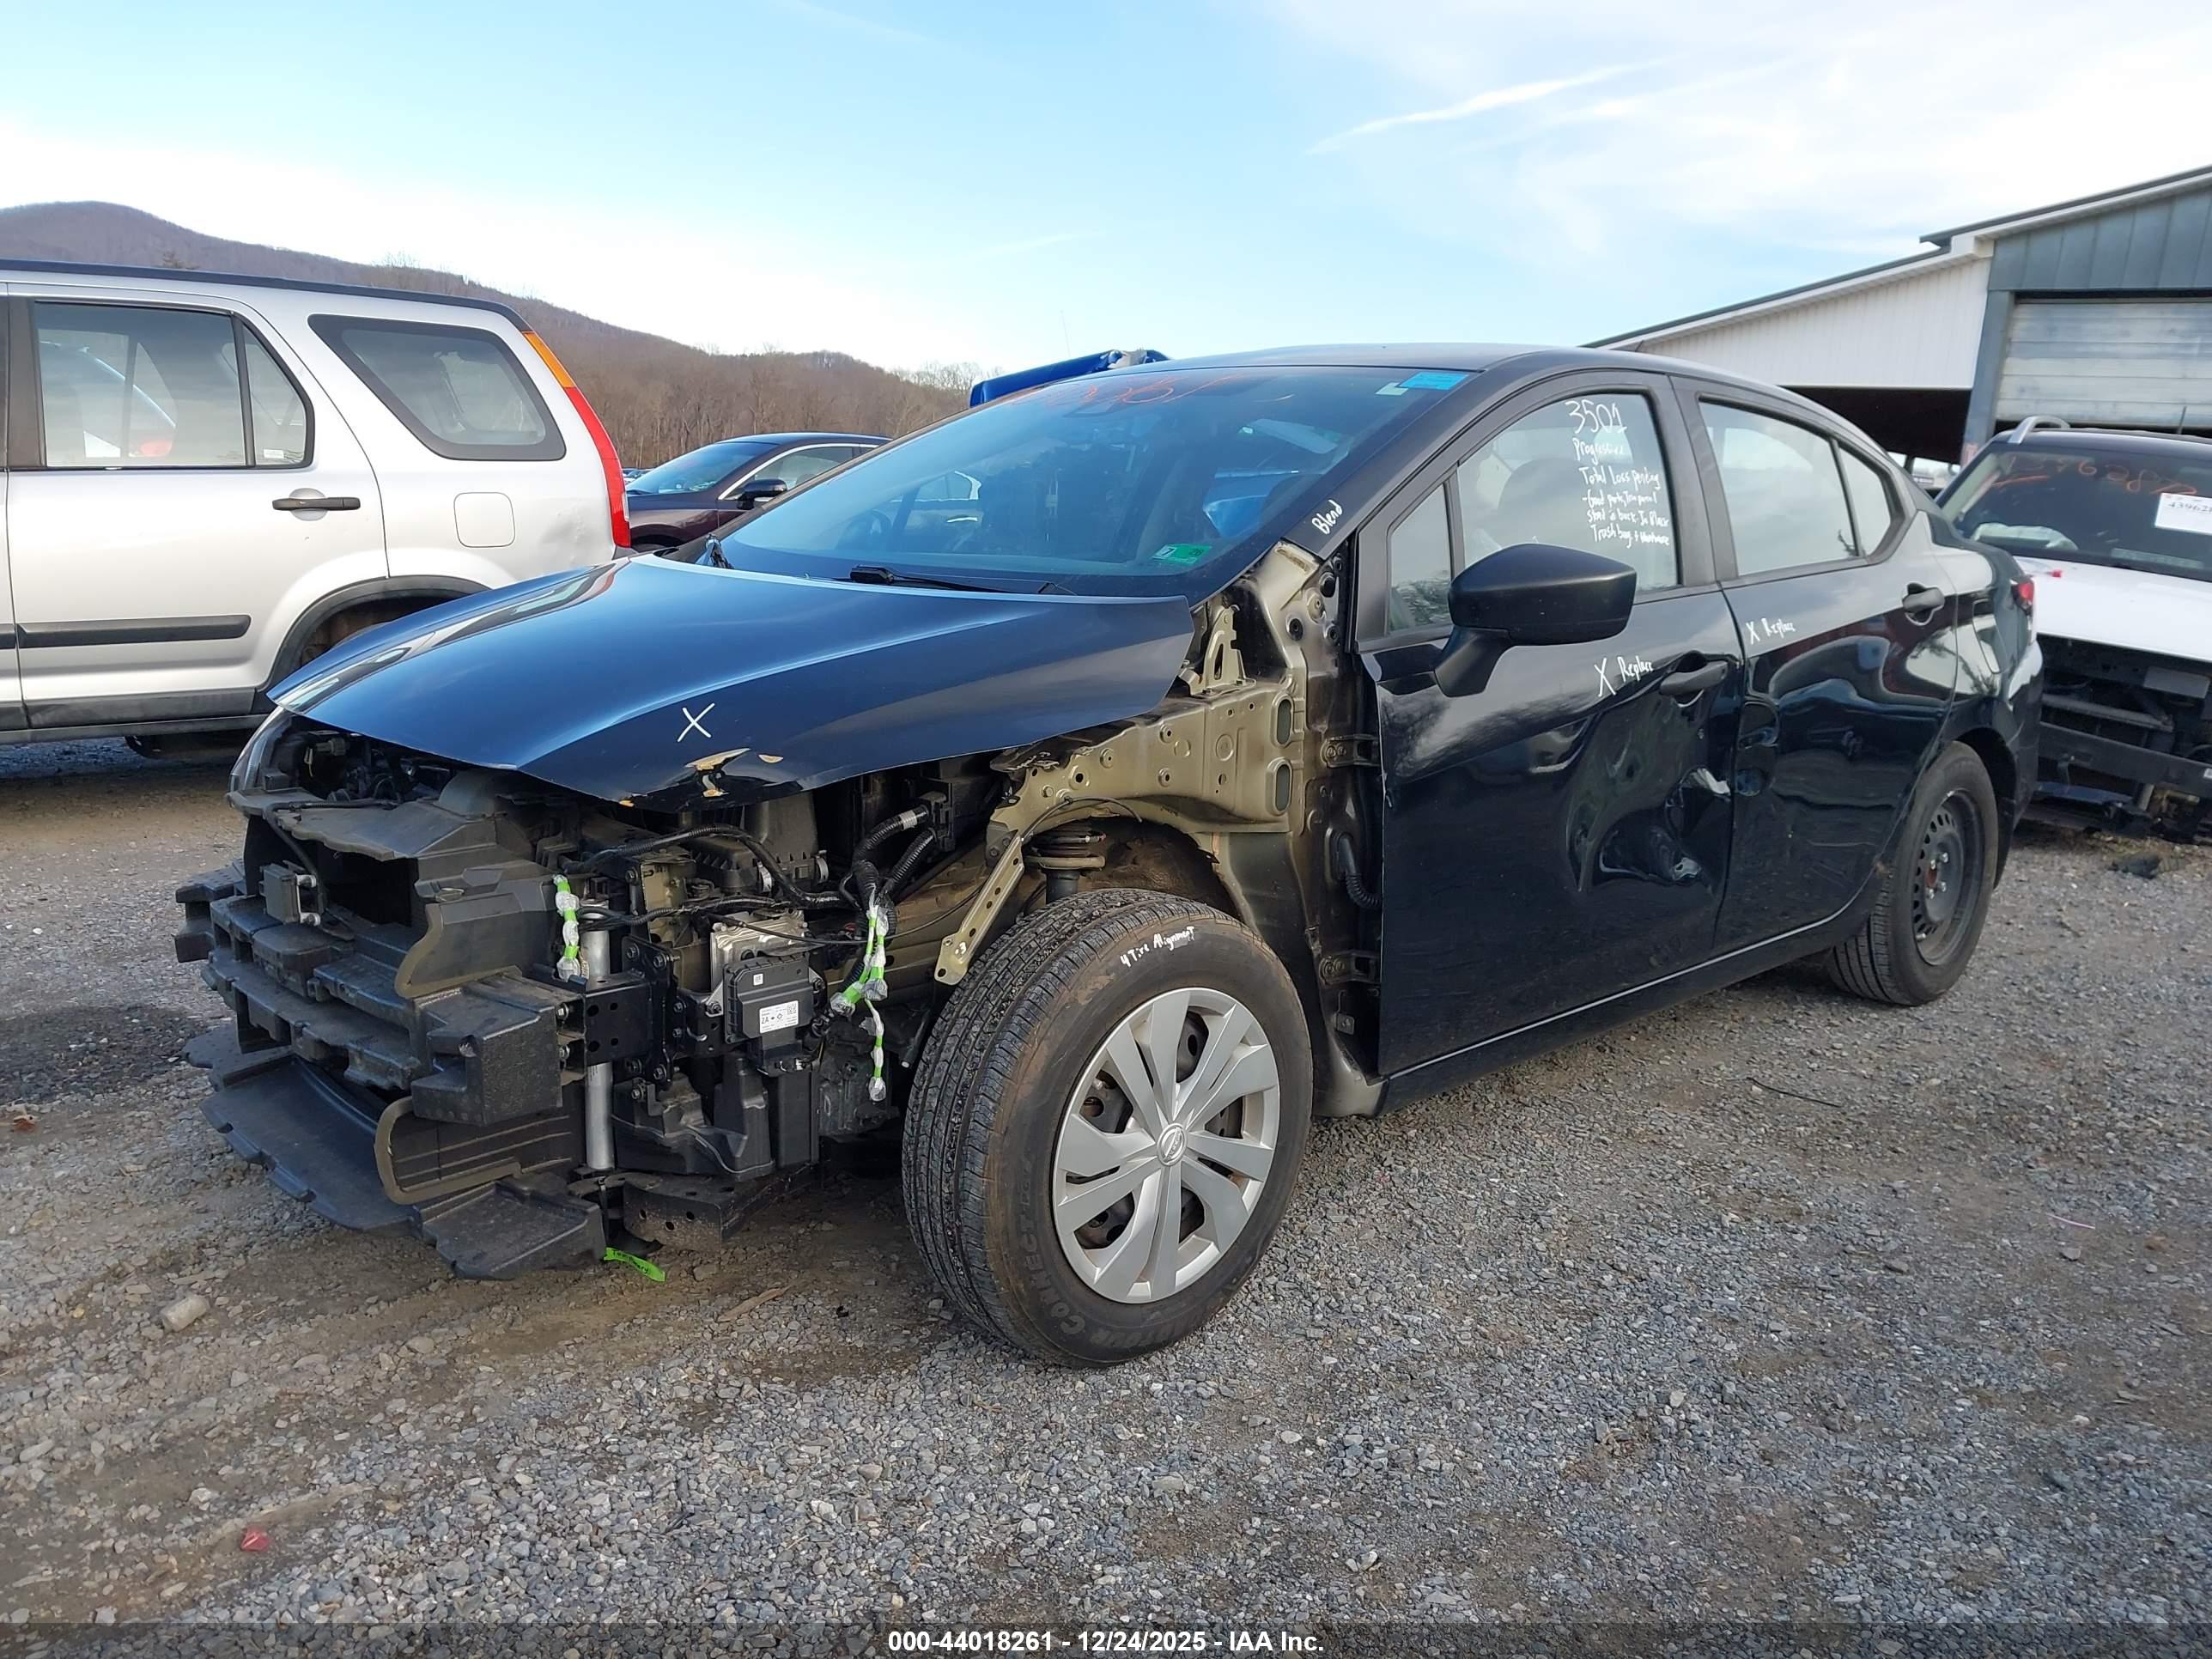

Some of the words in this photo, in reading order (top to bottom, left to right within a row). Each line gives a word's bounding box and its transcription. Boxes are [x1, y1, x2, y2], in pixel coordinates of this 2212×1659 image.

[1565, 399, 1628, 434] 3501
[1578, 465, 1607, 484] Total
[1608, 465, 1630, 484] Loss
[1311, 499, 1343, 535] Blend
[1590, 523, 1616, 542] Trash
[1617, 655, 1654, 683] Replace
[677, 702, 715, 743] X
[1127, 943, 1151, 962] Tire
